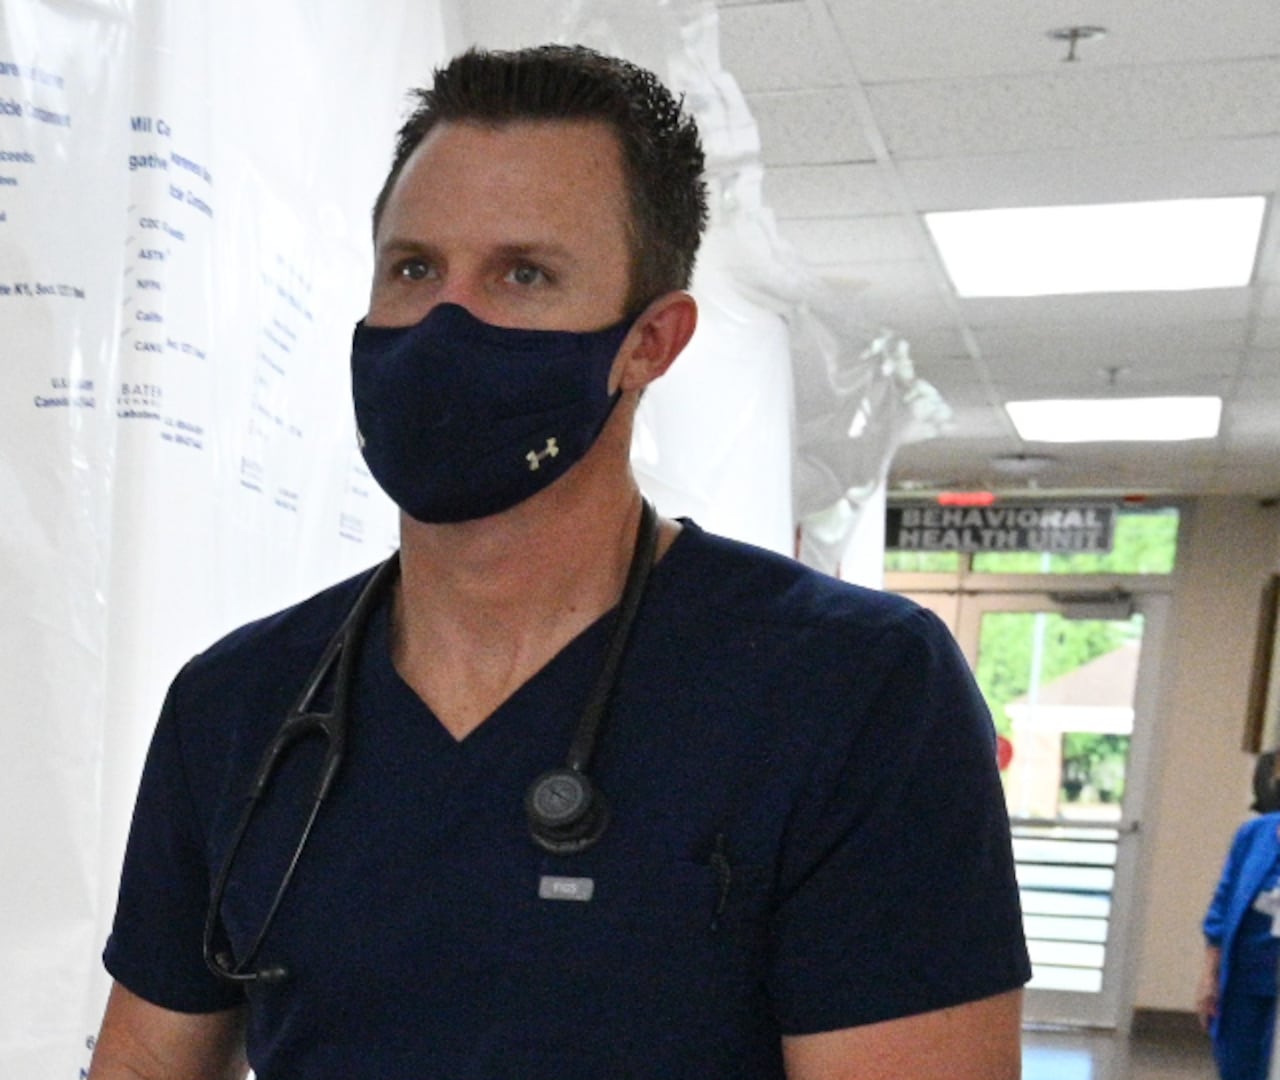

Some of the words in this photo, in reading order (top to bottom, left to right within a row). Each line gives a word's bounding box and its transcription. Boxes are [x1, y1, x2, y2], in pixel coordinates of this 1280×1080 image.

[901, 508, 1103, 529] BEHAVIORAL
[898, 529, 1018, 550] HEALTH
[1028, 530, 1101, 550] UNIT
